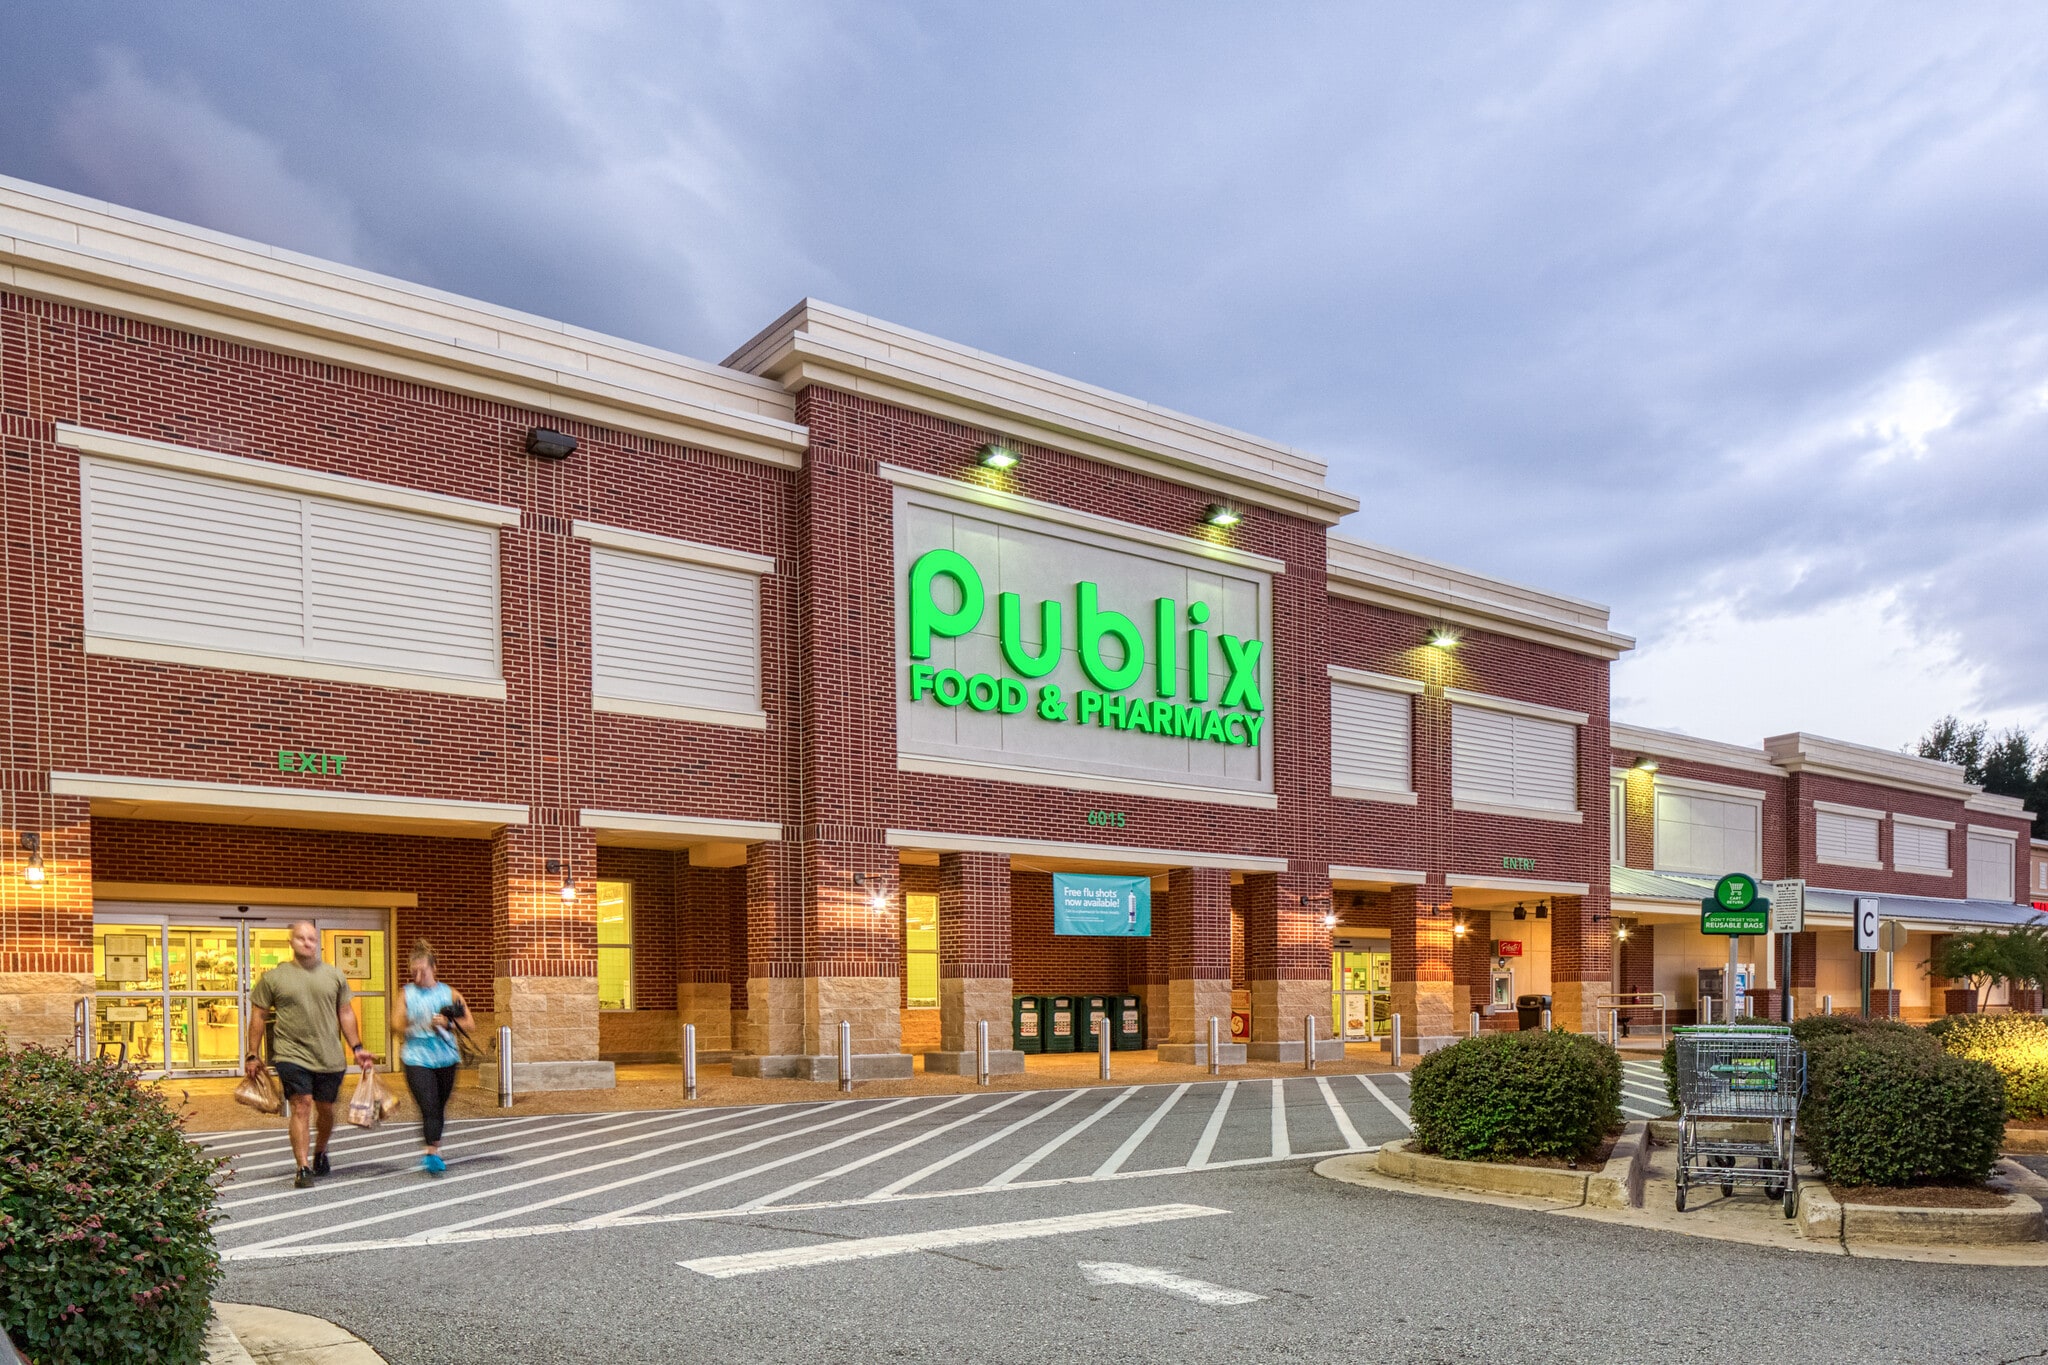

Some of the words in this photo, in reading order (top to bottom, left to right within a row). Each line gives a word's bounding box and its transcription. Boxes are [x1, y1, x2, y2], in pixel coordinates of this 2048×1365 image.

[909, 549, 1265, 711] Publix
[911, 664, 1028, 714] FOOD
[1037, 684, 1068, 721] &
[1077, 690, 1265, 747] PHARMACY
[278, 750, 348, 776] EXIT
[1087, 810, 1125, 827] 6015
[1503, 857, 1535, 871] ENTRY
[1064, 887, 1082, 897] Free
[1083, 887, 1094, 898] flu
[1064, 899, 1082, 907] now
[1083, 898, 1120, 908] available!
[1863, 911, 1875, 938] C
